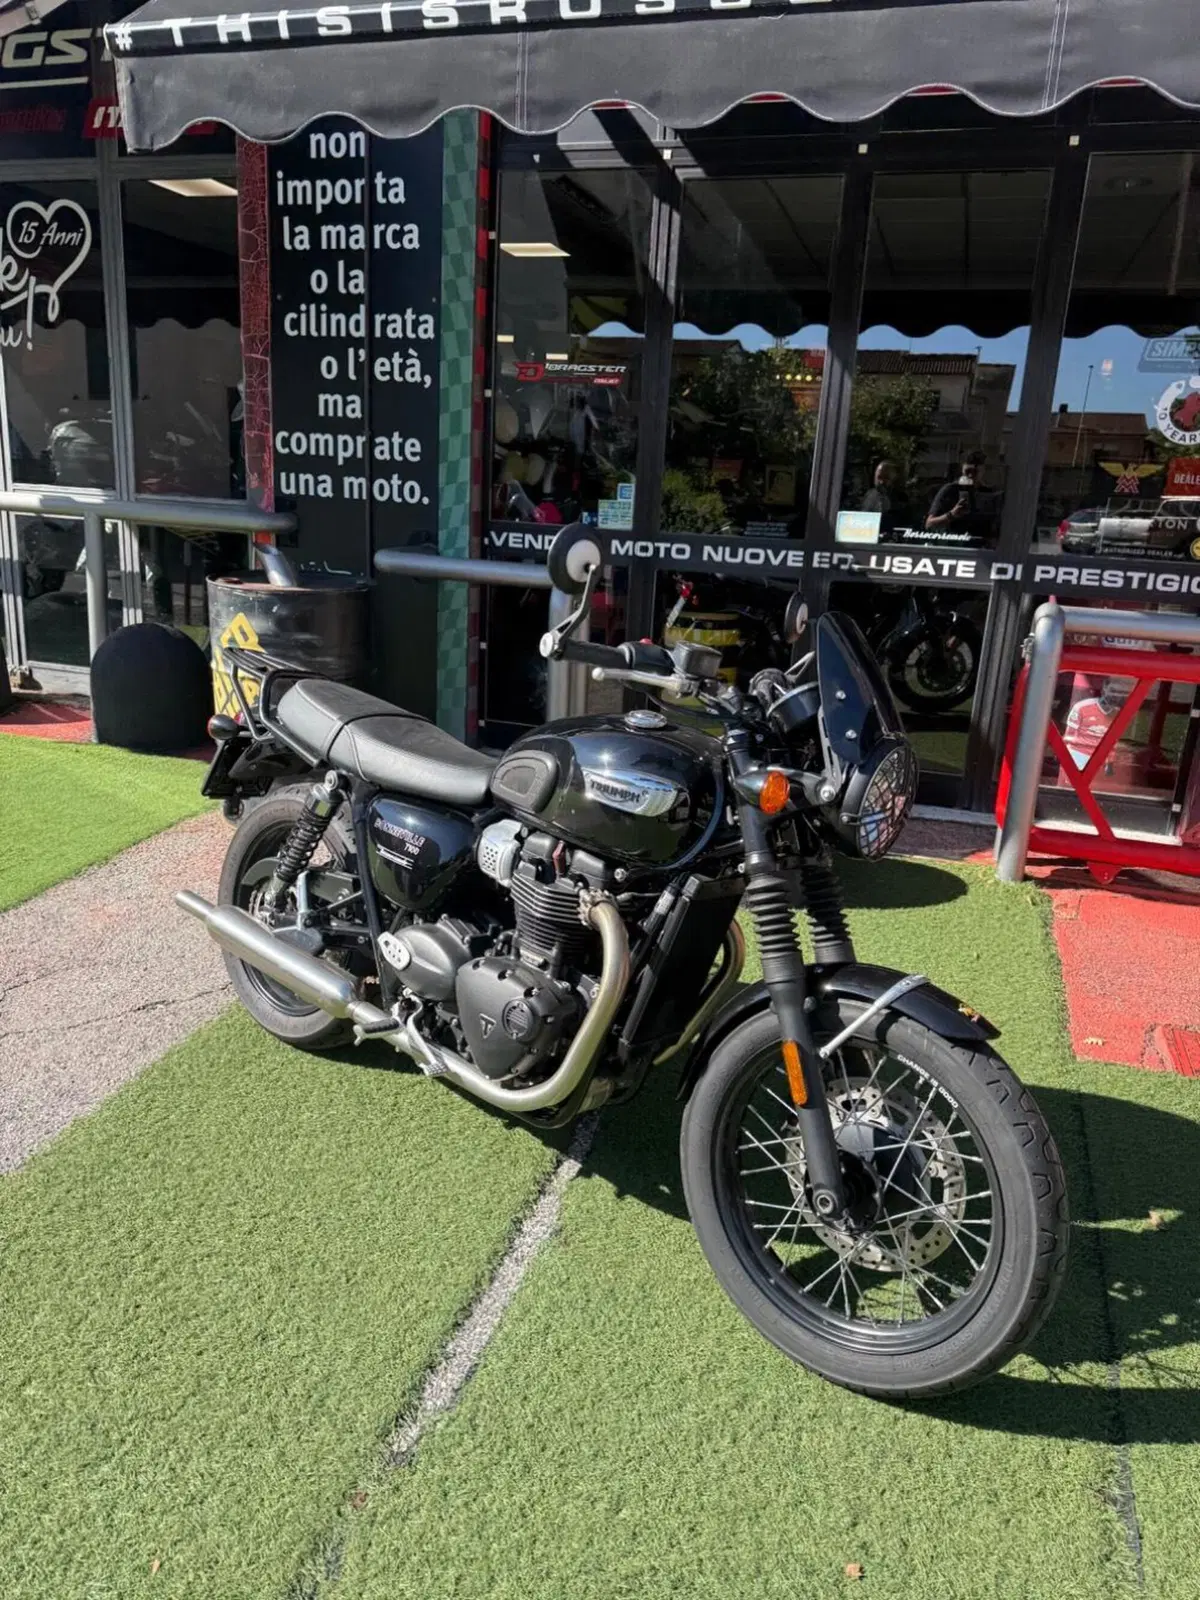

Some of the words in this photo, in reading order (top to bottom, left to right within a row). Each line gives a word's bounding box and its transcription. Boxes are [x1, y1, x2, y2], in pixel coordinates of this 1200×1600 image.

[309, 131, 366, 159] non
[18, 220, 39, 244] 15
[40, 221, 84, 247] Anni
[283, 217, 311, 251] la
[320, 223, 420, 251] marca
[310, 269, 328, 295] o
[337, 260, 365, 295] la
[284, 305, 436, 340] cilindrata
[320, 356, 338, 381] o
[318, 393, 362, 419] ma
[275, 430, 422, 465] comprate
[279, 471, 333, 499] una
[342, 473, 431, 505] moto.
[610, 539, 691, 560] MOTO
[702, 545, 805, 568] NUOVE
[868, 554, 977, 579] USATE
[989, 562, 1023, 580] DI
[590, 779, 641, 802] TRIUMPH
[938, 1086, 959, 1109] GOOD
